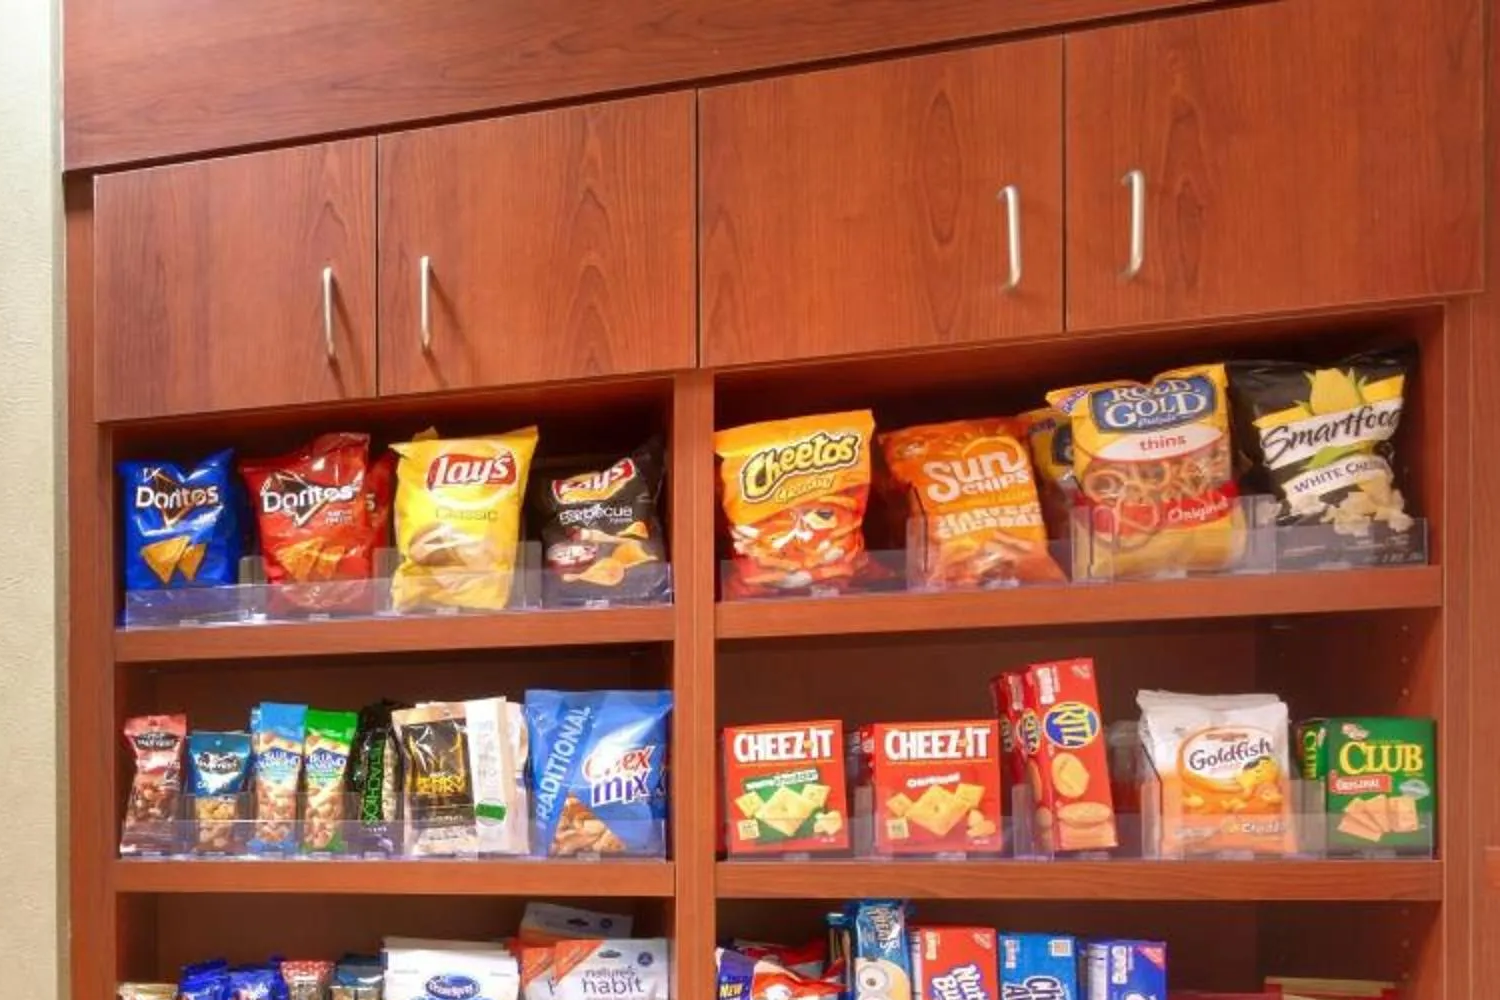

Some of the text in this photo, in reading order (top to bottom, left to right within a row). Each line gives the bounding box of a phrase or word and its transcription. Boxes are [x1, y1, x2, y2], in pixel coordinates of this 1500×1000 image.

[1112, 379, 1192, 401] ROLD
[1104, 390, 1207, 428] GOLD
[1140, 436, 1186, 452] thins
[743, 433, 858, 499] Cheetos
[1293, 467, 1343, 493] WHITE
[135, 483, 219, 509] Doritos
[263, 484, 357, 514] Doritos
[436, 507, 499, 523] Classic
[1189, 735, 1273, 771] Goldfish
[1339, 741, 1424, 775] CLUB
[593, 771, 649, 804] mix
[582, 976, 645, 995] habit
